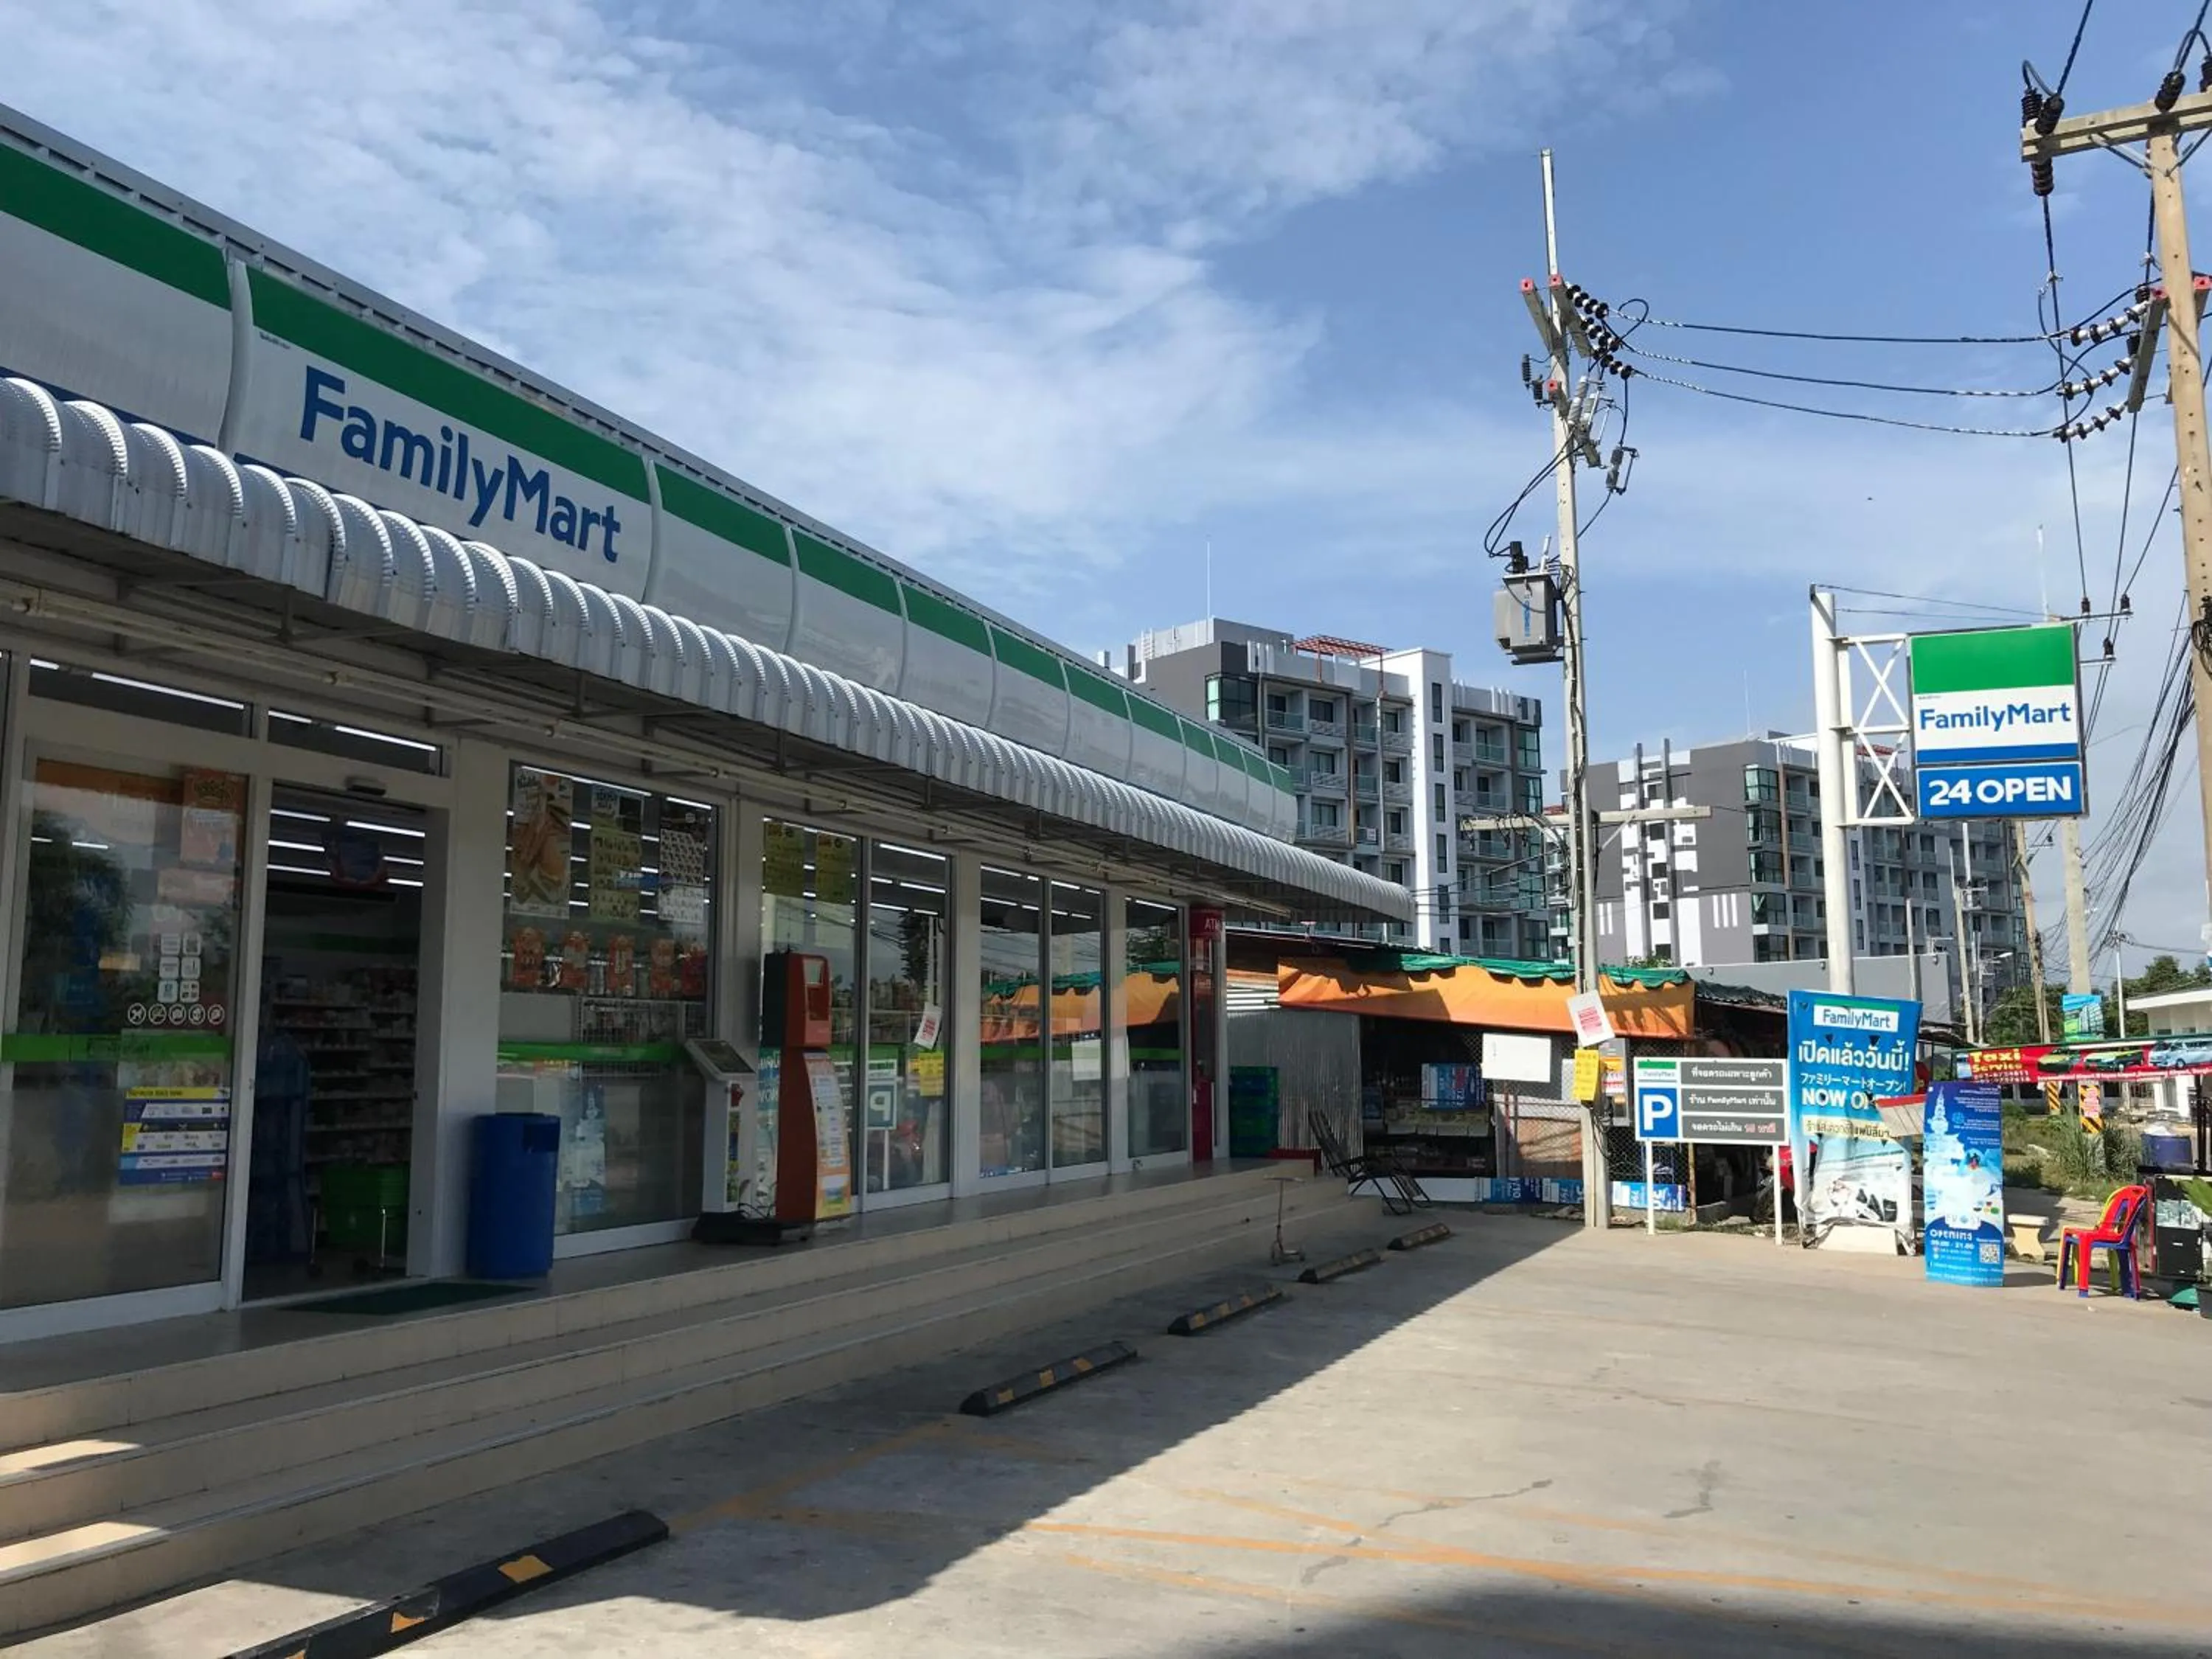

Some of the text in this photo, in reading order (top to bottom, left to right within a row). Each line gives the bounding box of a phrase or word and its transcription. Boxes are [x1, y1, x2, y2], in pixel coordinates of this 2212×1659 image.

[300, 365, 622, 563] FamilyMart
[1919, 703, 2071, 731] FamilyMart
[1929, 776, 2073, 806] 24 OPEN
[1823, 1008, 1891, 1029] FamilyMart
[1798, 1039, 1910, 1071] เปิดแล้ววันนี้!
[1969, 1048, 2021, 1062] Taxi
[1972, 1062, 2023, 1073] Service
[1801, 1088, 1847, 1107] NOW
[1642, 1093, 1674, 1131] P
